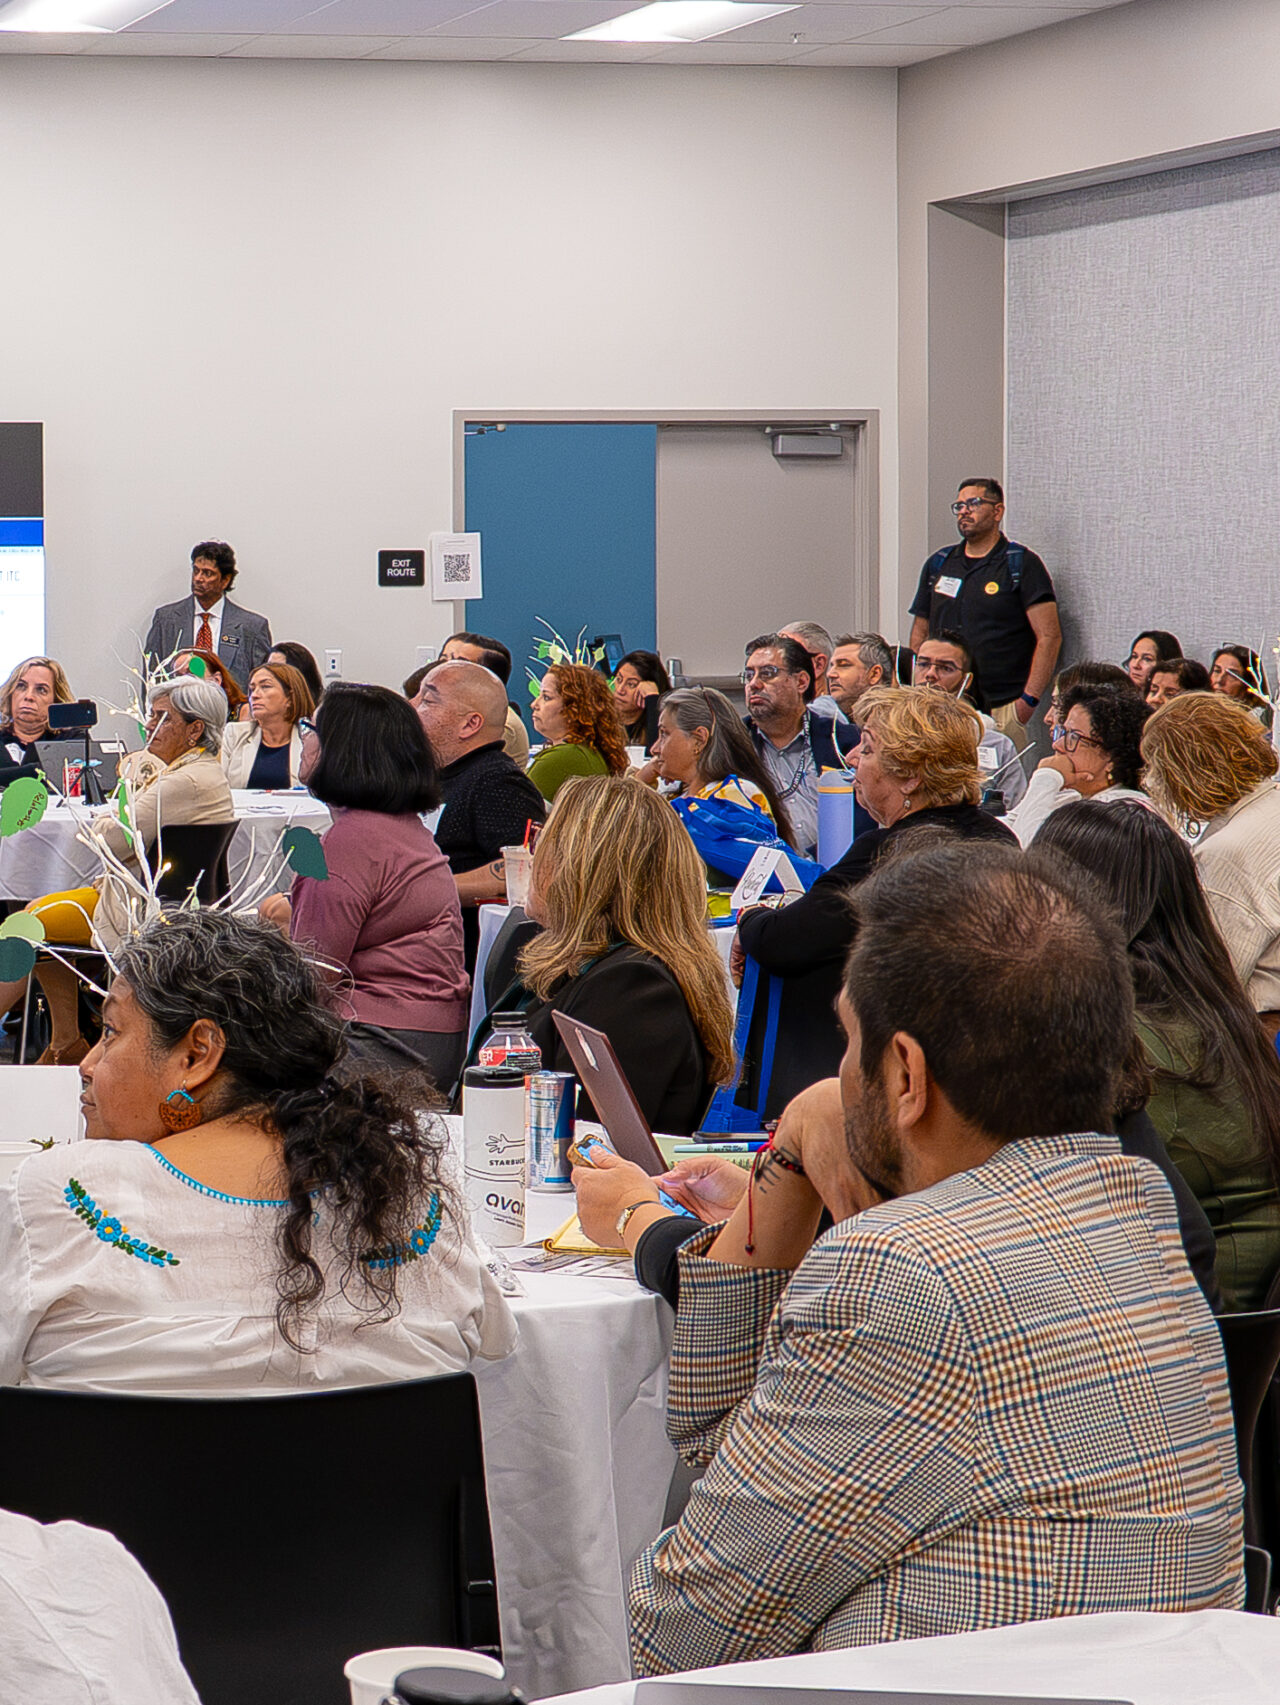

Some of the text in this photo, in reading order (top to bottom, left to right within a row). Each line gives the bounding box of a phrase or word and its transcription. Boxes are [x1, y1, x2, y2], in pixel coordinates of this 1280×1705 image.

[392, 559, 411, 568] EXIT
[387, 568, 416, 577] ROUTE
[489, 1157, 525, 1166] STARBUC
